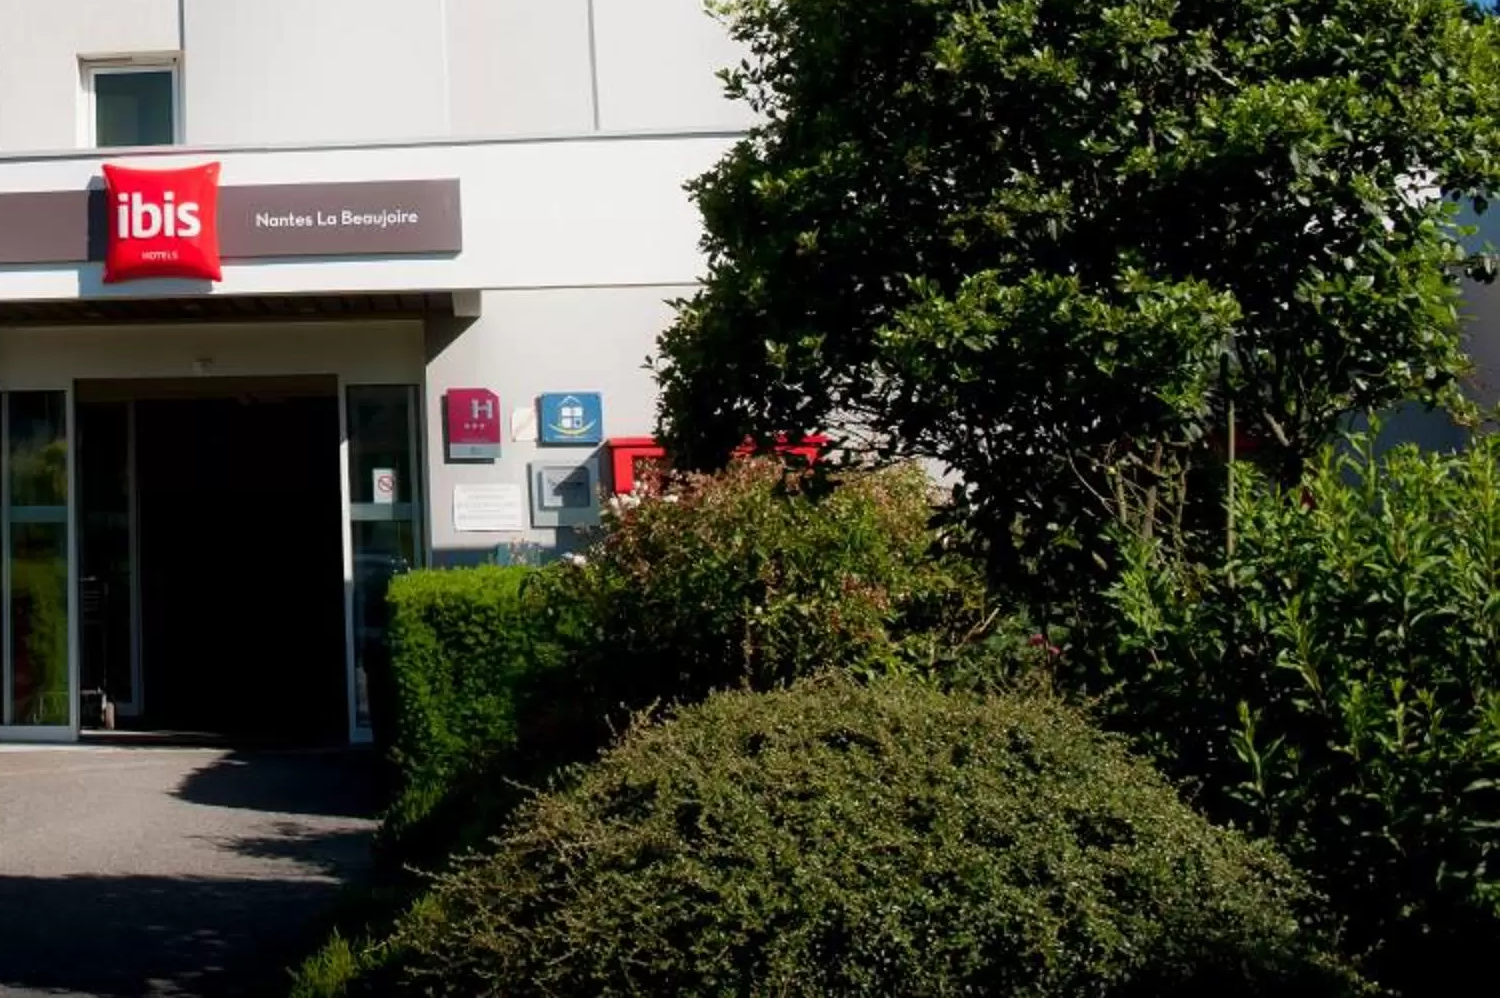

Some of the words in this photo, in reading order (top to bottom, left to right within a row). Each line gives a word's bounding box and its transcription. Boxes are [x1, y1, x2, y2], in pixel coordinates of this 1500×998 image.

[117, 190, 202, 239] ibis
[255, 211, 314, 228] Nantes
[317, 210, 337, 226] La
[341, 208, 419, 229] Beaujoire
[141, 250, 179, 262] HOTELS
[471, 398, 493, 420] H
